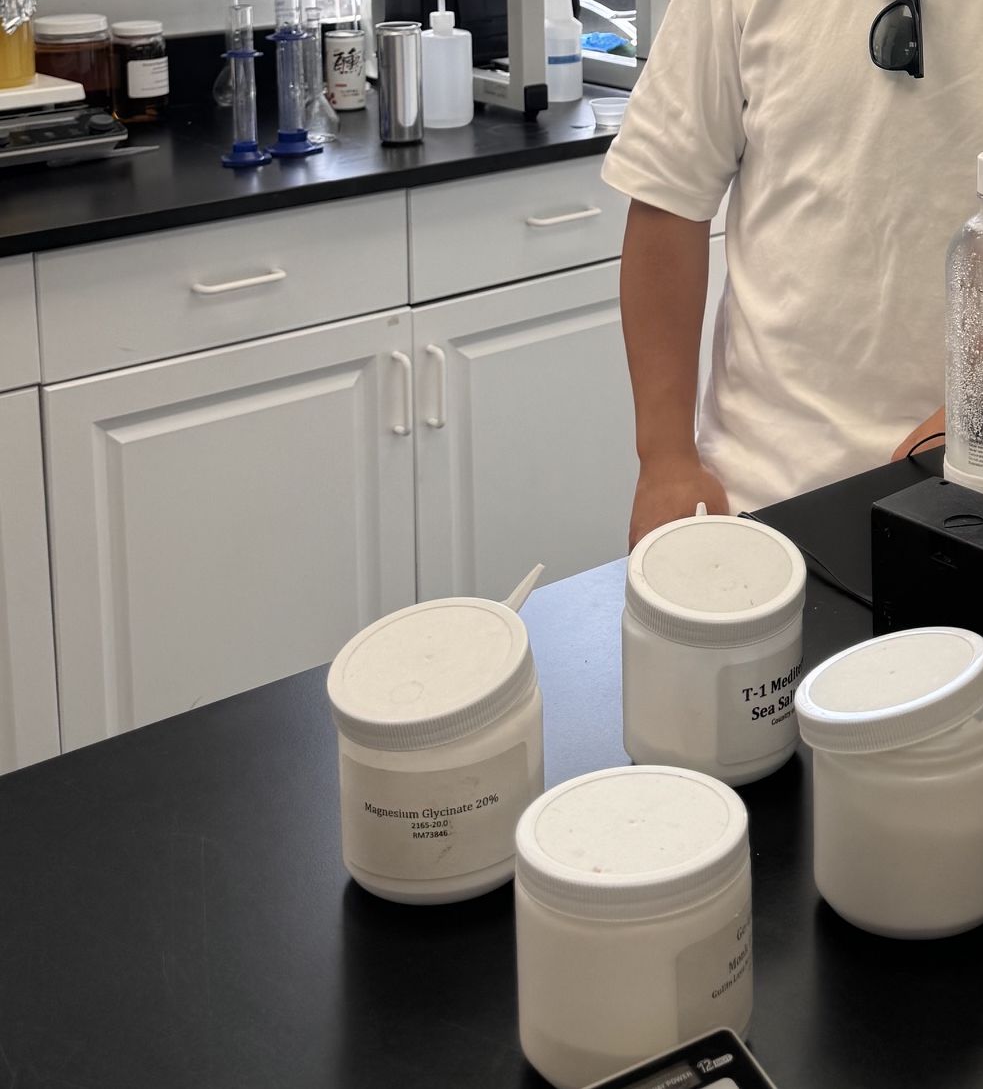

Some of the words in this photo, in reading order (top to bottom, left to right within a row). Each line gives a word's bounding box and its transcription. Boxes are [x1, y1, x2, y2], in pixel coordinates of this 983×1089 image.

[742, 683, 768, 702] T-1
[751, 703, 775, 721] Sea
[364, 802, 419, 819] Magnesium
[421, 803, 473, 821] Glycinate
[475, 793, 499, 809] 20%
[697, 1058, 714, 1074] 12
